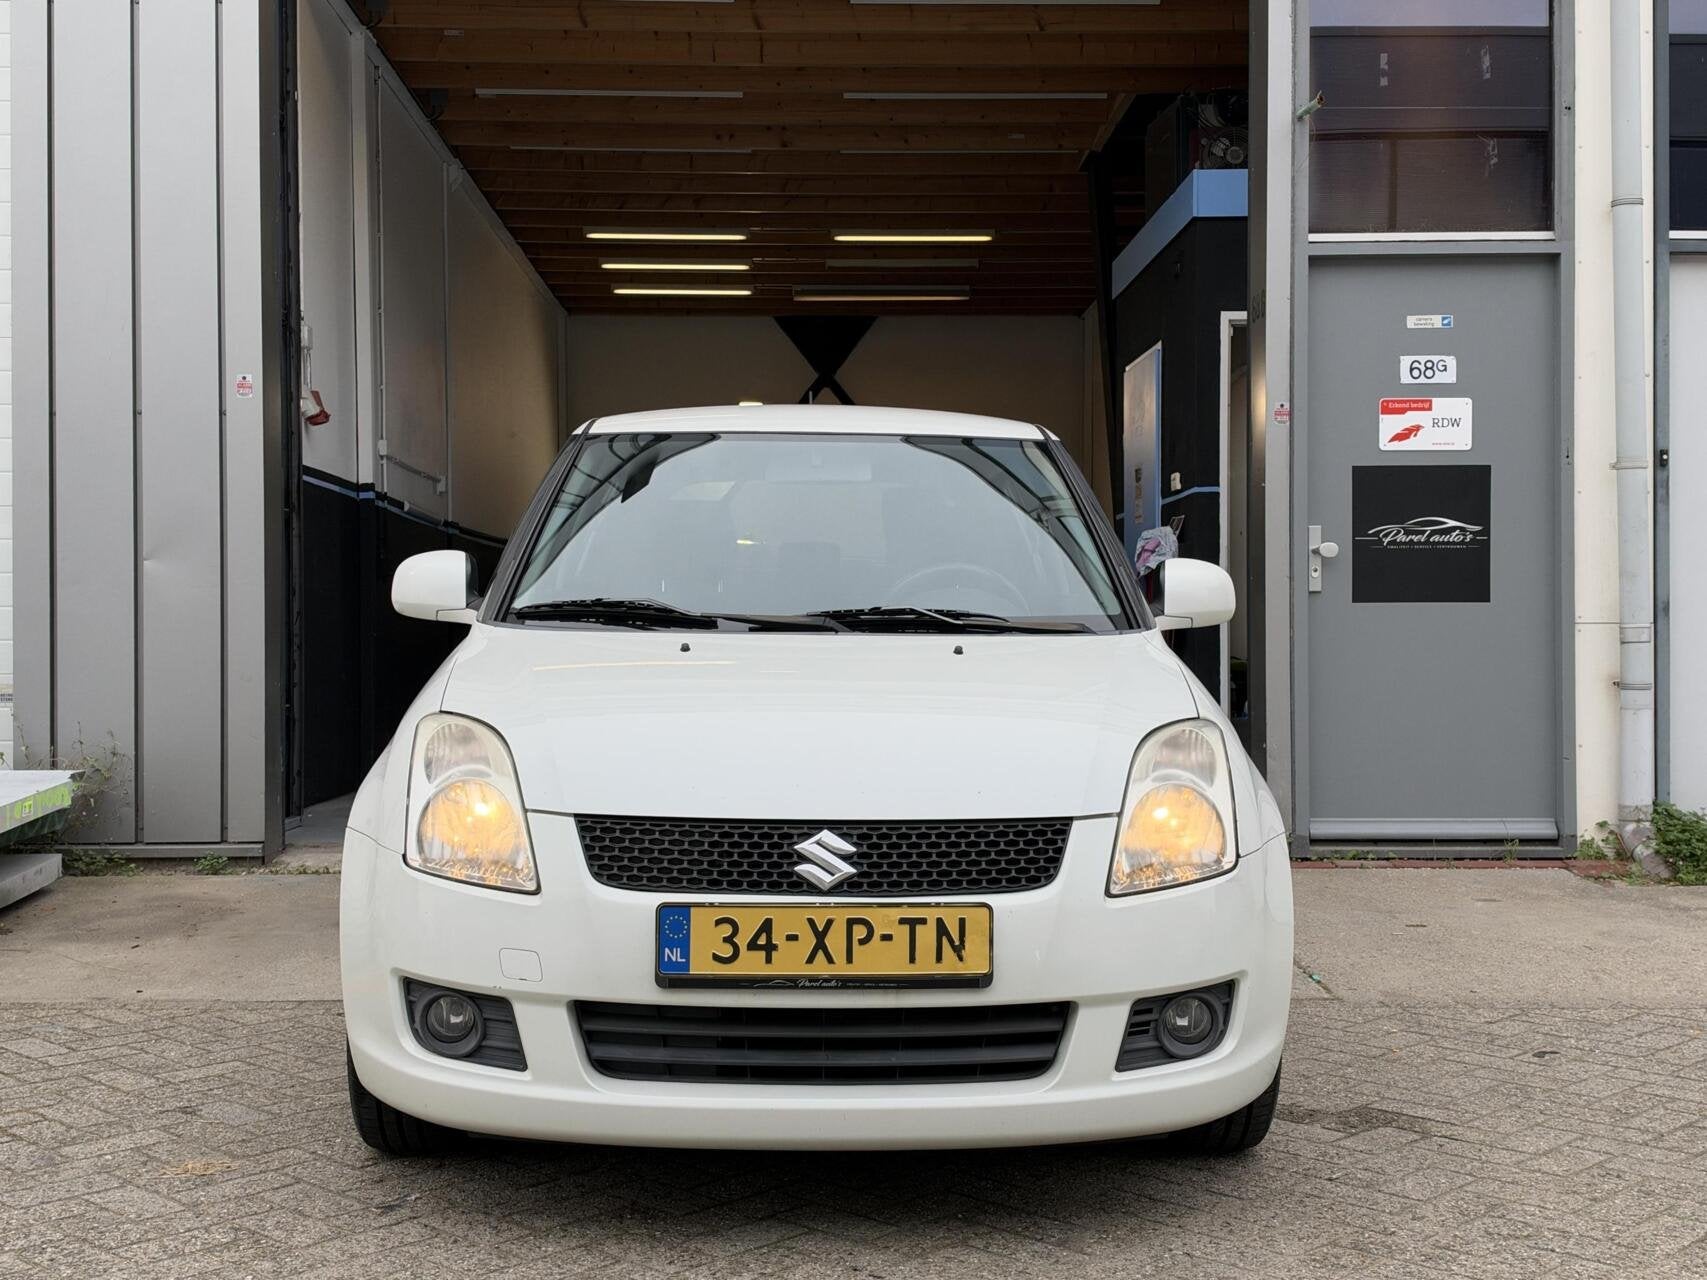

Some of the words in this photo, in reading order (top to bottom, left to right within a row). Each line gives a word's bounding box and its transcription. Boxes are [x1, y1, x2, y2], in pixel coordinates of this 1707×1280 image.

[1409, 359, 1448, 380] 68G
[1431, 417, 1462, 428] RDW
[1380, 528, 1431, 546] Parel
[1430, 529, 1474, 542] auto's
[711, 916, 968, 965] 34-XP-TN
[664, 947, 686, 962] NL
